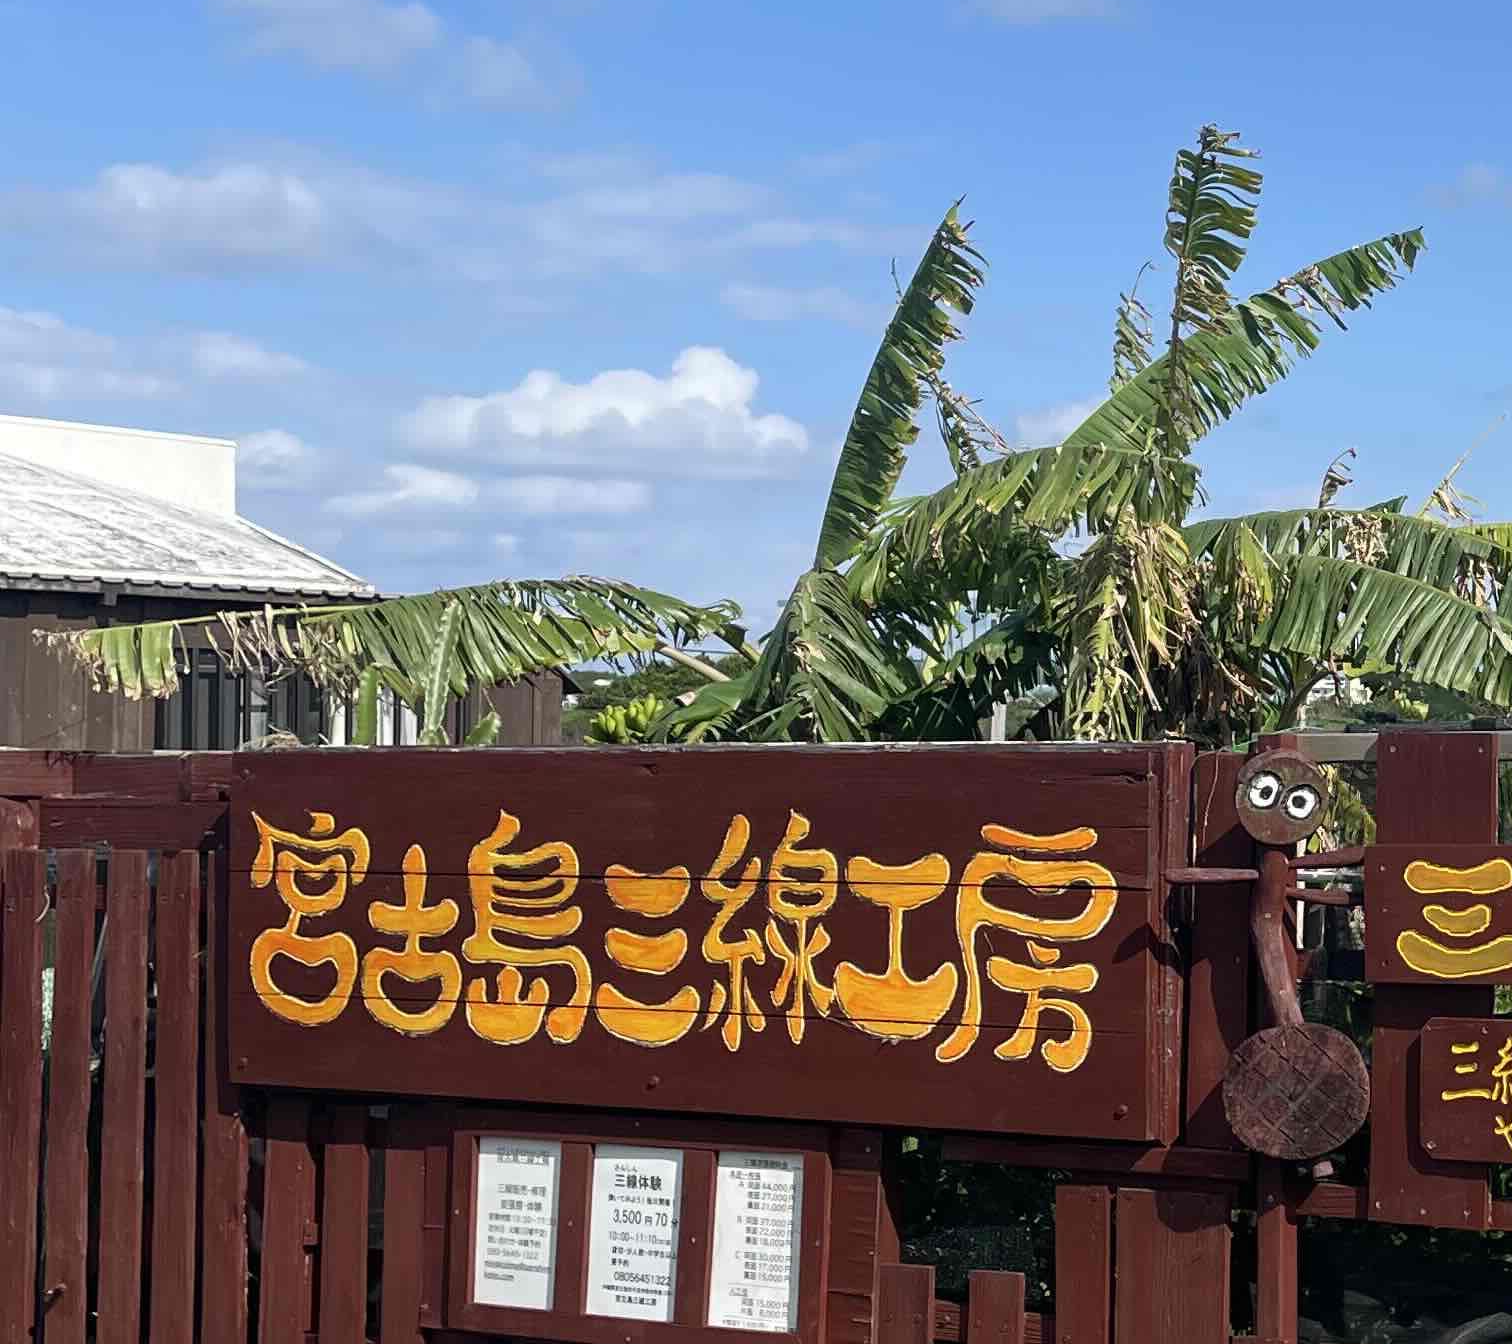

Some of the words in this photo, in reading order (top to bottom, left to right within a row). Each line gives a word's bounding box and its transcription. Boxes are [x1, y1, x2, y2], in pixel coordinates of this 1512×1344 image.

[249, 809, 1120, 1073] 宮古島三線工房
